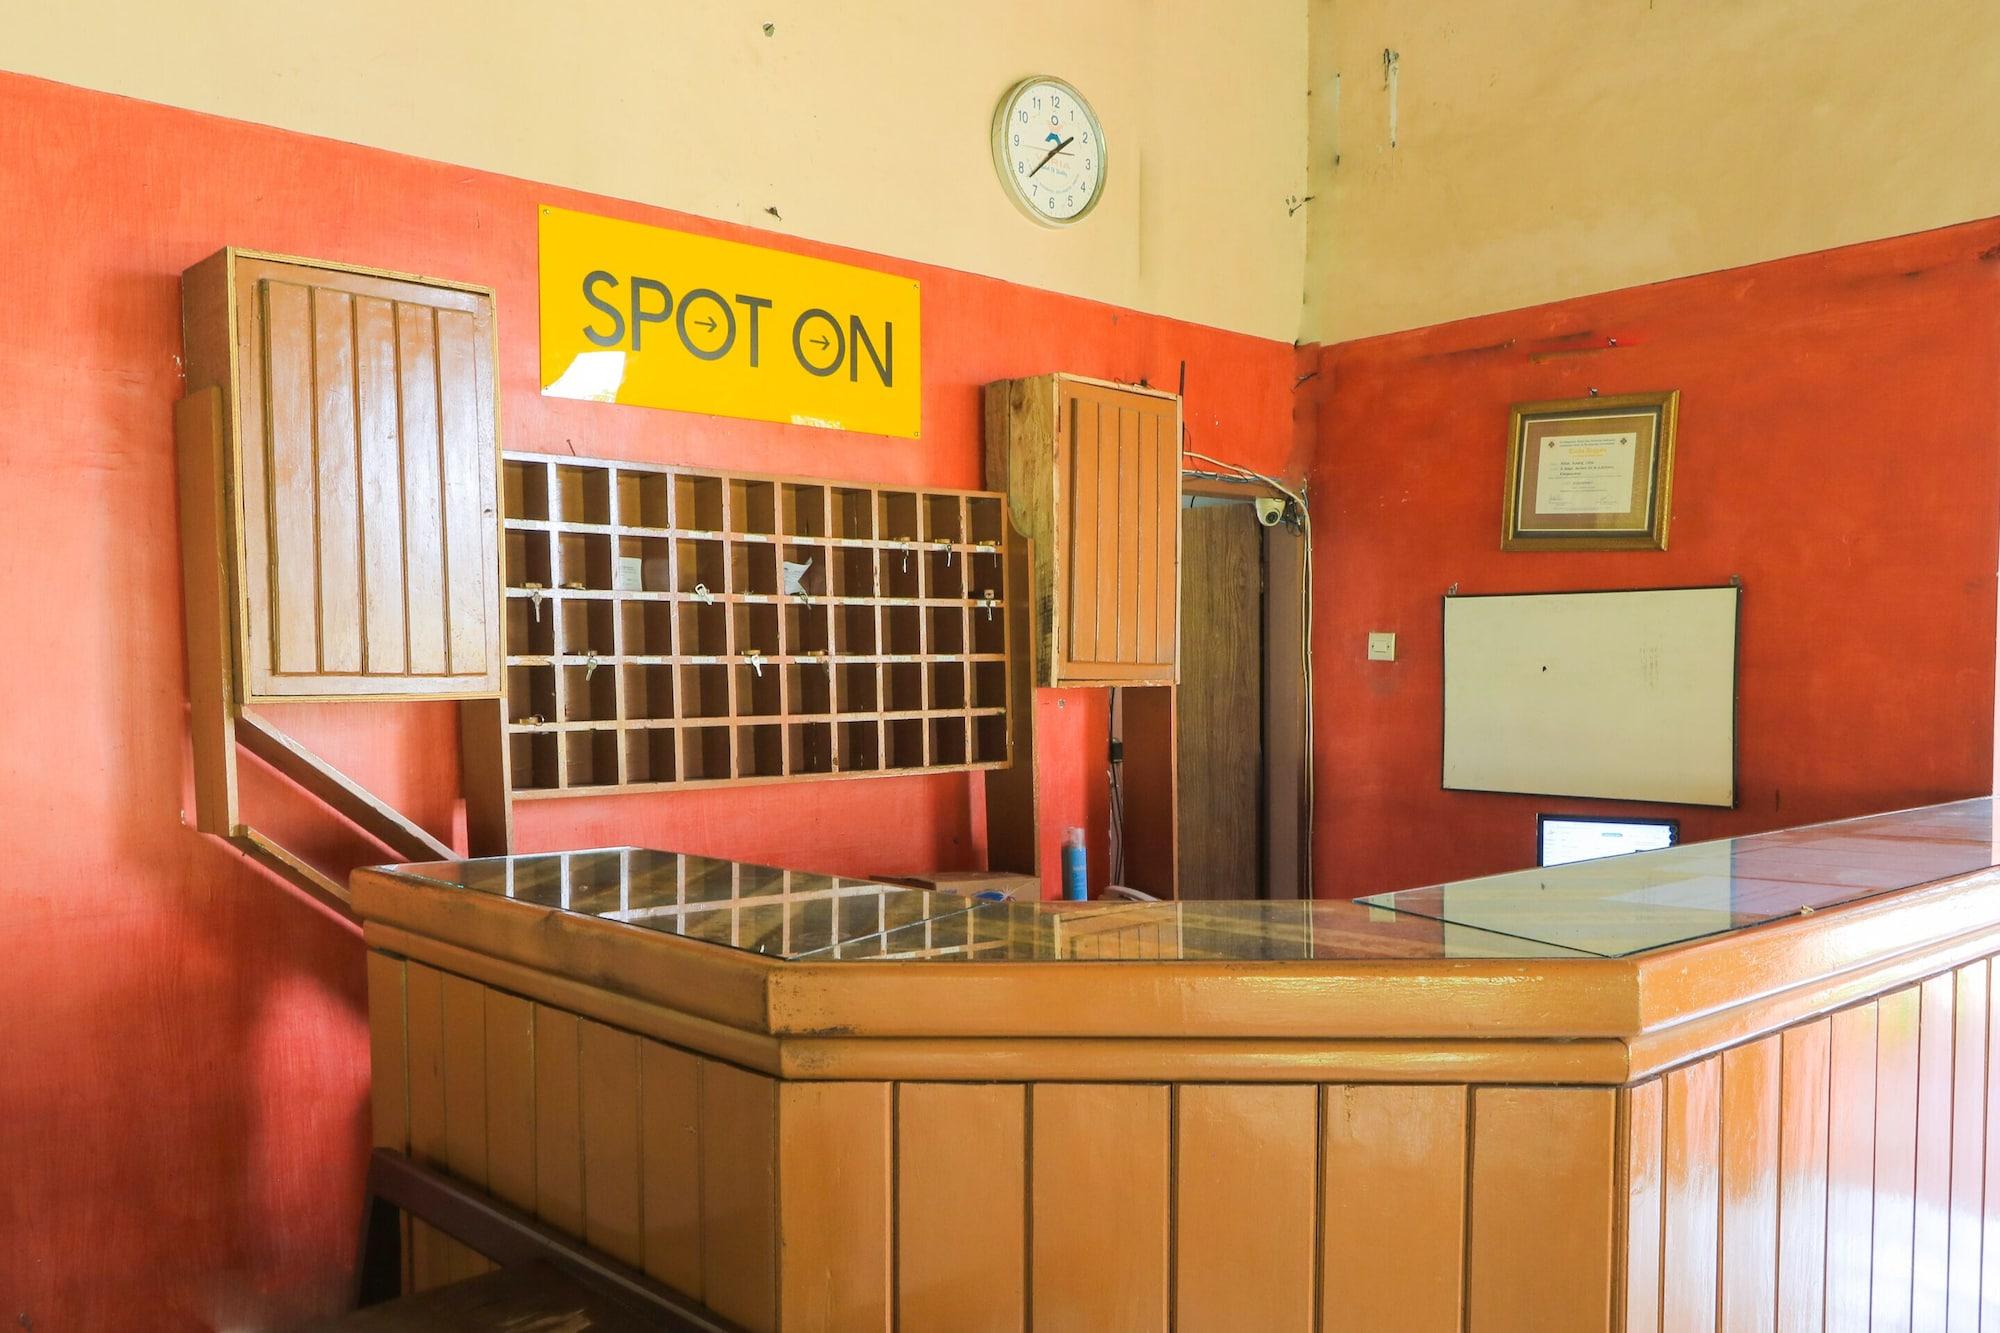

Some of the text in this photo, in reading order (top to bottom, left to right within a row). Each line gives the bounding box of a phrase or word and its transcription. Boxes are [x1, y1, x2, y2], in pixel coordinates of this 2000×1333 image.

[1032, 97, 1041, 110] 11
[1050, 95, 1061, 109] 12
[1018, 109, 1029, 124] 10
[1013, 134, 1020, 147] 9
[1082, 132, 1089, 144] 2
[1018, 162, 1025, 174] 8
[1085, 158, 1091, 170] 3
[1032, 184, 1038, 197] 7
[1080, 181, 1086, 192] 4
[1048, 196, 1055, 209] 6
[1067, 195, 1074, 207] 5
[582, 270, 893, 388] SPOT ON
